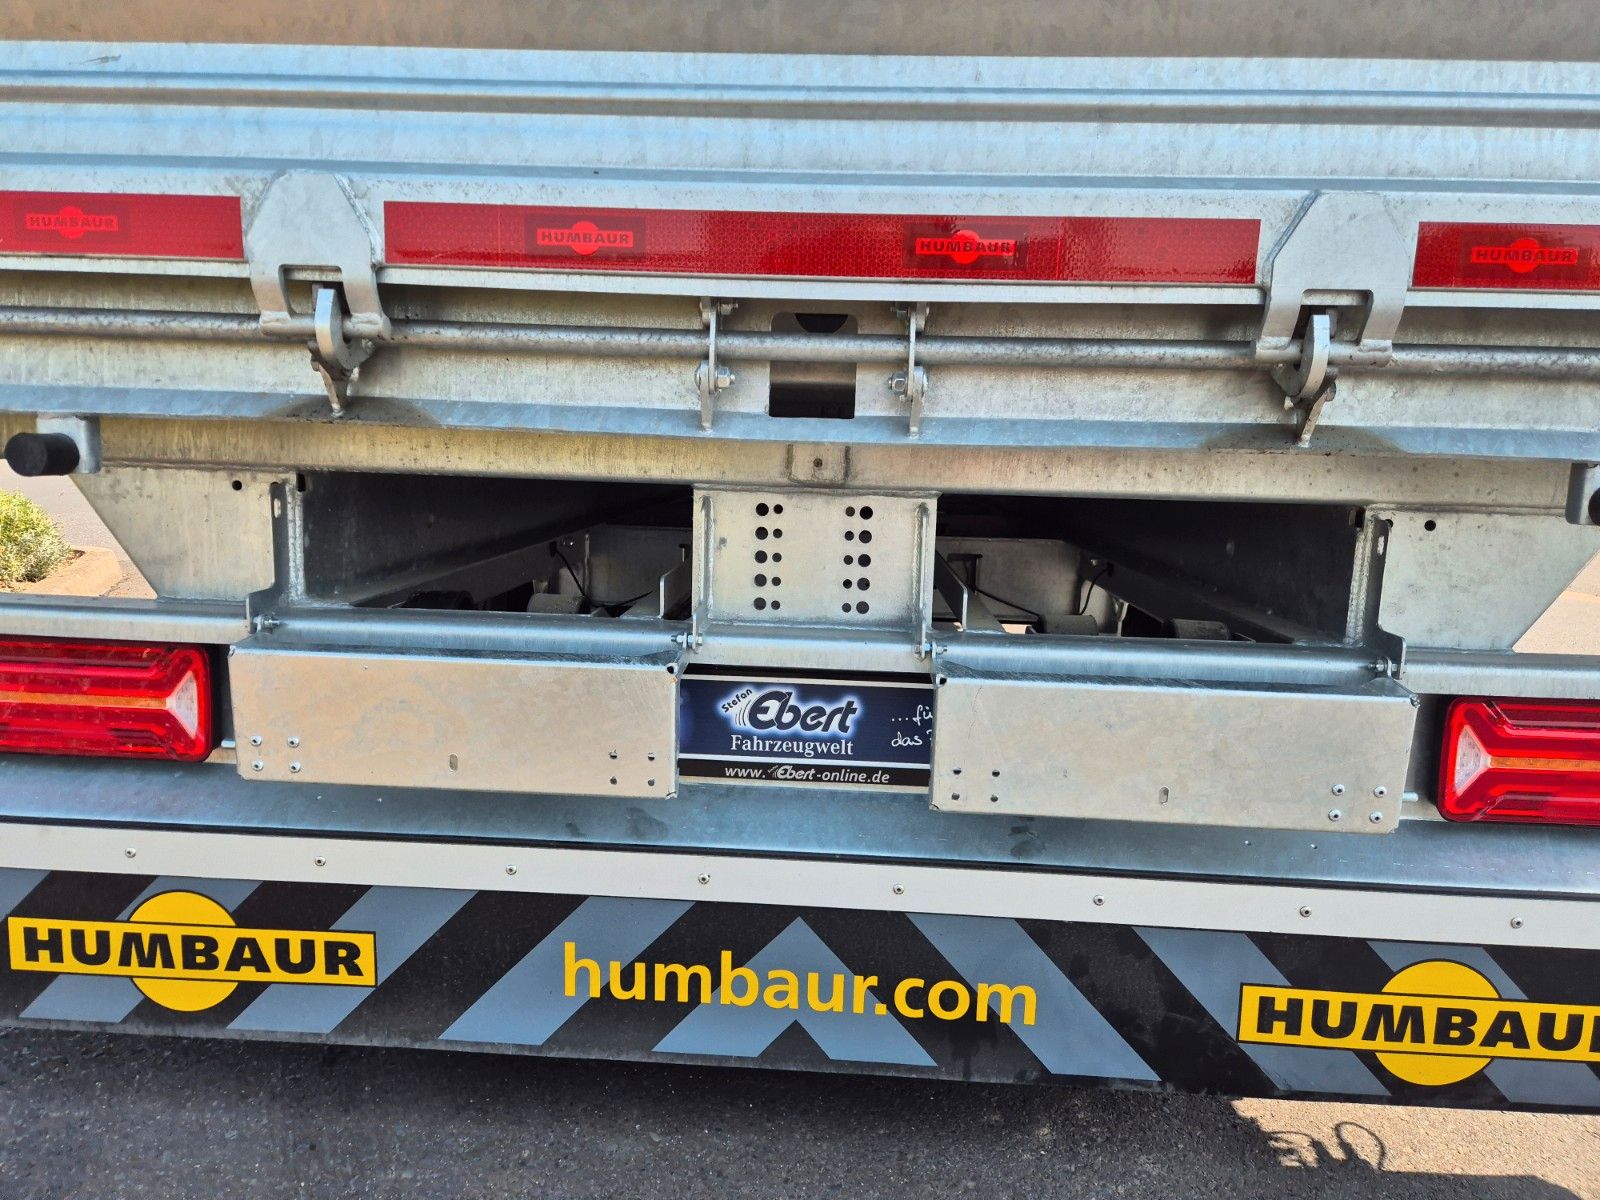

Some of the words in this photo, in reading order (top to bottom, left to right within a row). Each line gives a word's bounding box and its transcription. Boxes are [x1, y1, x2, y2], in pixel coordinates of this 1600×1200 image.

[29, 215, 115, 229] HUMBAUR
[541, 231, 629, 244] HUMBAUR
[919, 240, 1010, 253] HUMBAUR
[1476, 250, 1572, 262] HUMBAUR
[721, 688, 753, 713] Stefan
[748, 690, 858, 734] Ebert
[730, 734, 854, 757] Fahrzeugwelt
[22, 926, 365, 977] HUMBAUR
[563, 941, 1037, 1026] humbaur.com
